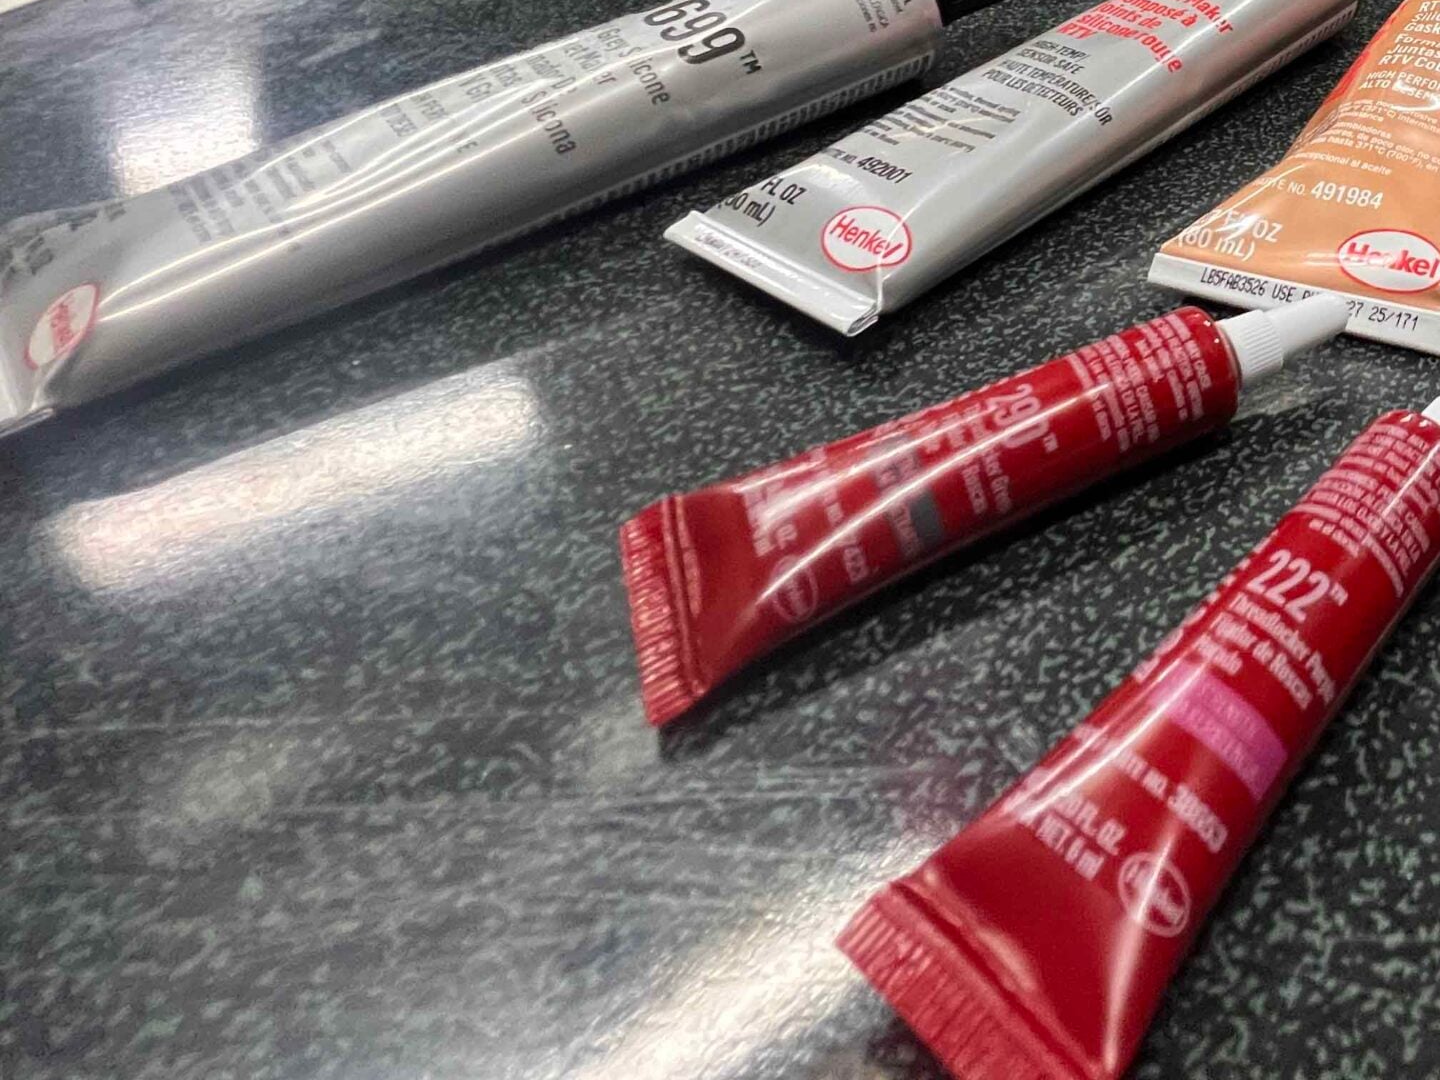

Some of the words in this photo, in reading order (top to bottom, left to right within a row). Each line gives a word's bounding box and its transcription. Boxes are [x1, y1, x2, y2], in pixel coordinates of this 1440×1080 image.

[1077, 14, 1139, 40] silicone
[1138, 16, 1162, 30] de
[1181, 9, 1199, 27] à
[1058, 22, 1098, 40] RTV
[1053, 59, 1086, 75] SAFE
[1378, 54, 1412, 66] RTV
[982, 69, 1007, 85] POUR
[1006, 76, 1023, 89] LES
[1358, 79, 1391, 90] ALTO
[1366, 70, 1396, 80] HIGH
[1371, 136, 1395, 148] poco
[1417, 150, 1430, 160] no
[856, 156, 913, 184] 492001
[1361, 162, 1392, 176] aceite
[1426, 161, 1440, 171] en
[761, 176, 779, 197] FL
[780, 183, 807, 205] OZ
[1288, 181, 1305, 195] NO.
[1311, 181, 1383, 210] 491984
[743, 199, 776, 227] mL)
[829, 215, 904, 259] Henkel
[1253, 218, 1283, 244] OZ
[1214, 234, 1257, 262] mL)
[1271, 284, 1297, 303] USE
[1368, 306, 1420, 331] 25/171
[1246, 549, 1348, 623] 222™
